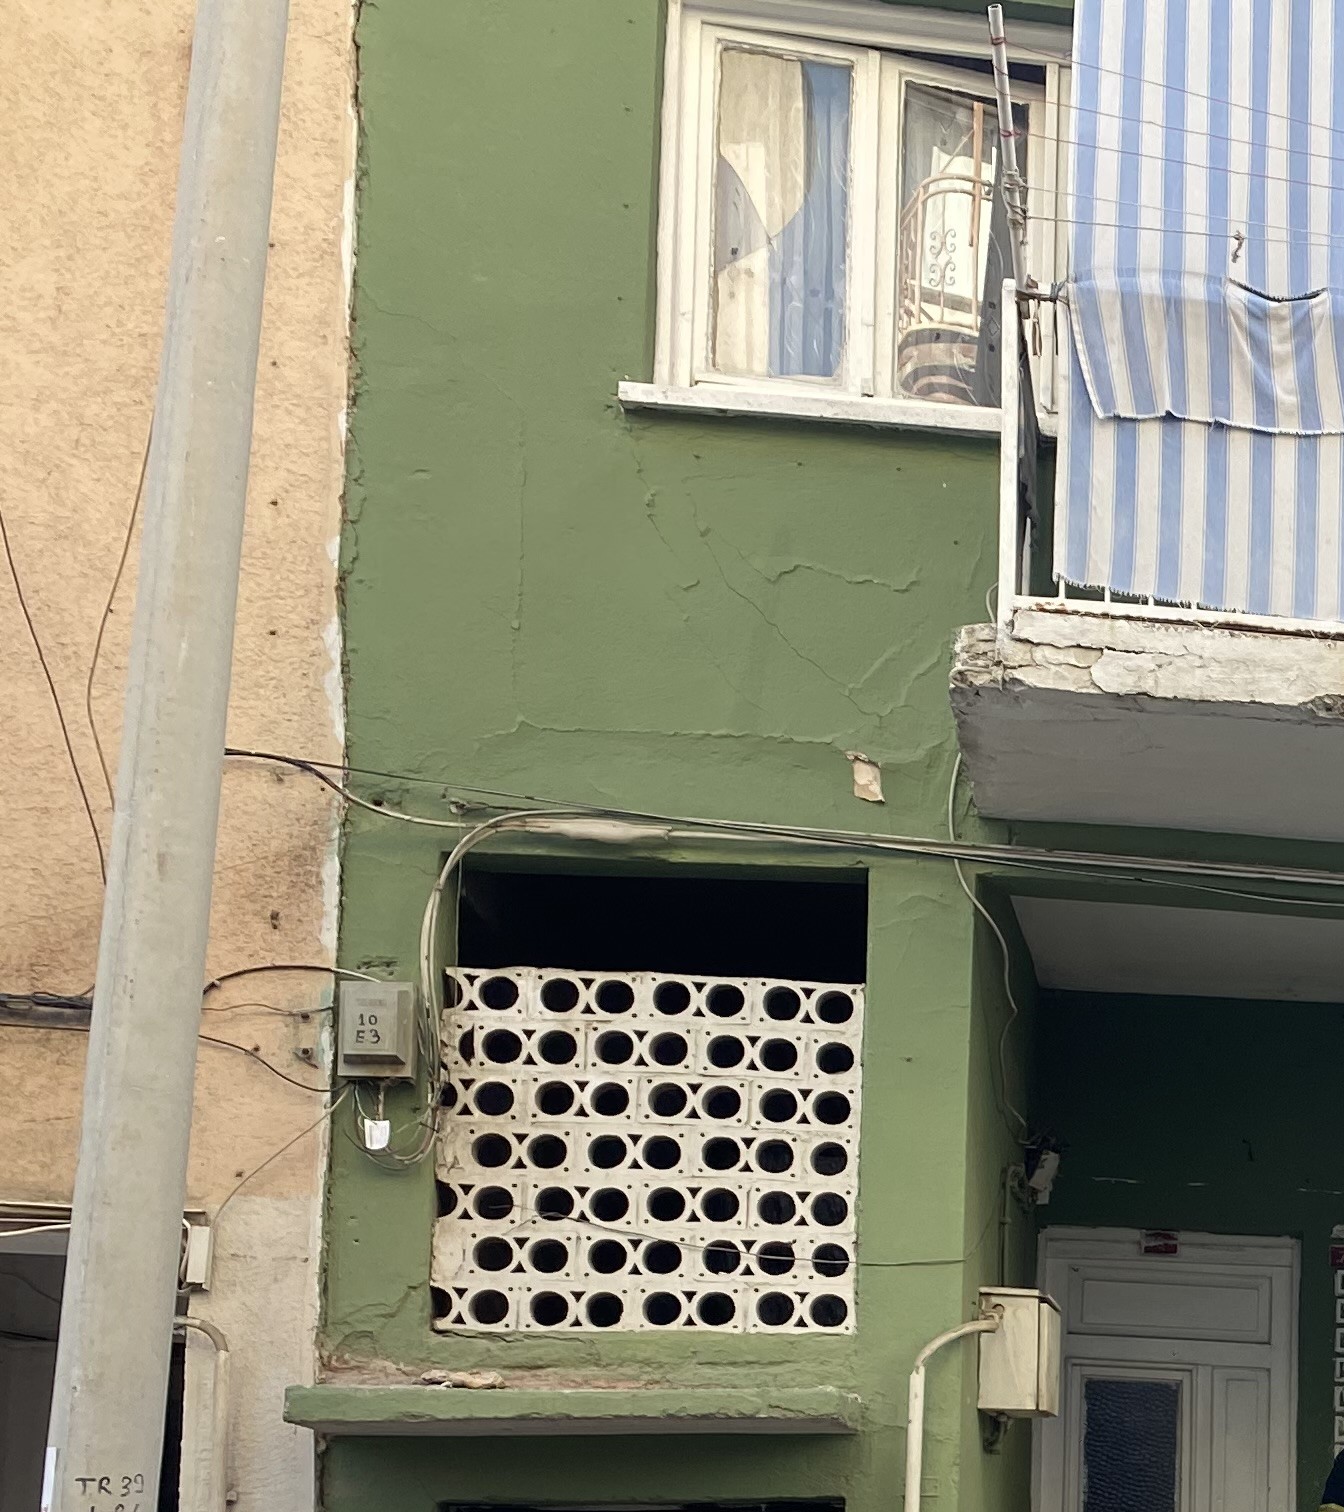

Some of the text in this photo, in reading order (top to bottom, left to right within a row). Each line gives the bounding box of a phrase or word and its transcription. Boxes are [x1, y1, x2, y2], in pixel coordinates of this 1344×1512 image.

[358, 1013, 378, 1027] 10
[355, 1029, 381, 1044] E3
[75, 1473, 145, 1497] TR 39
